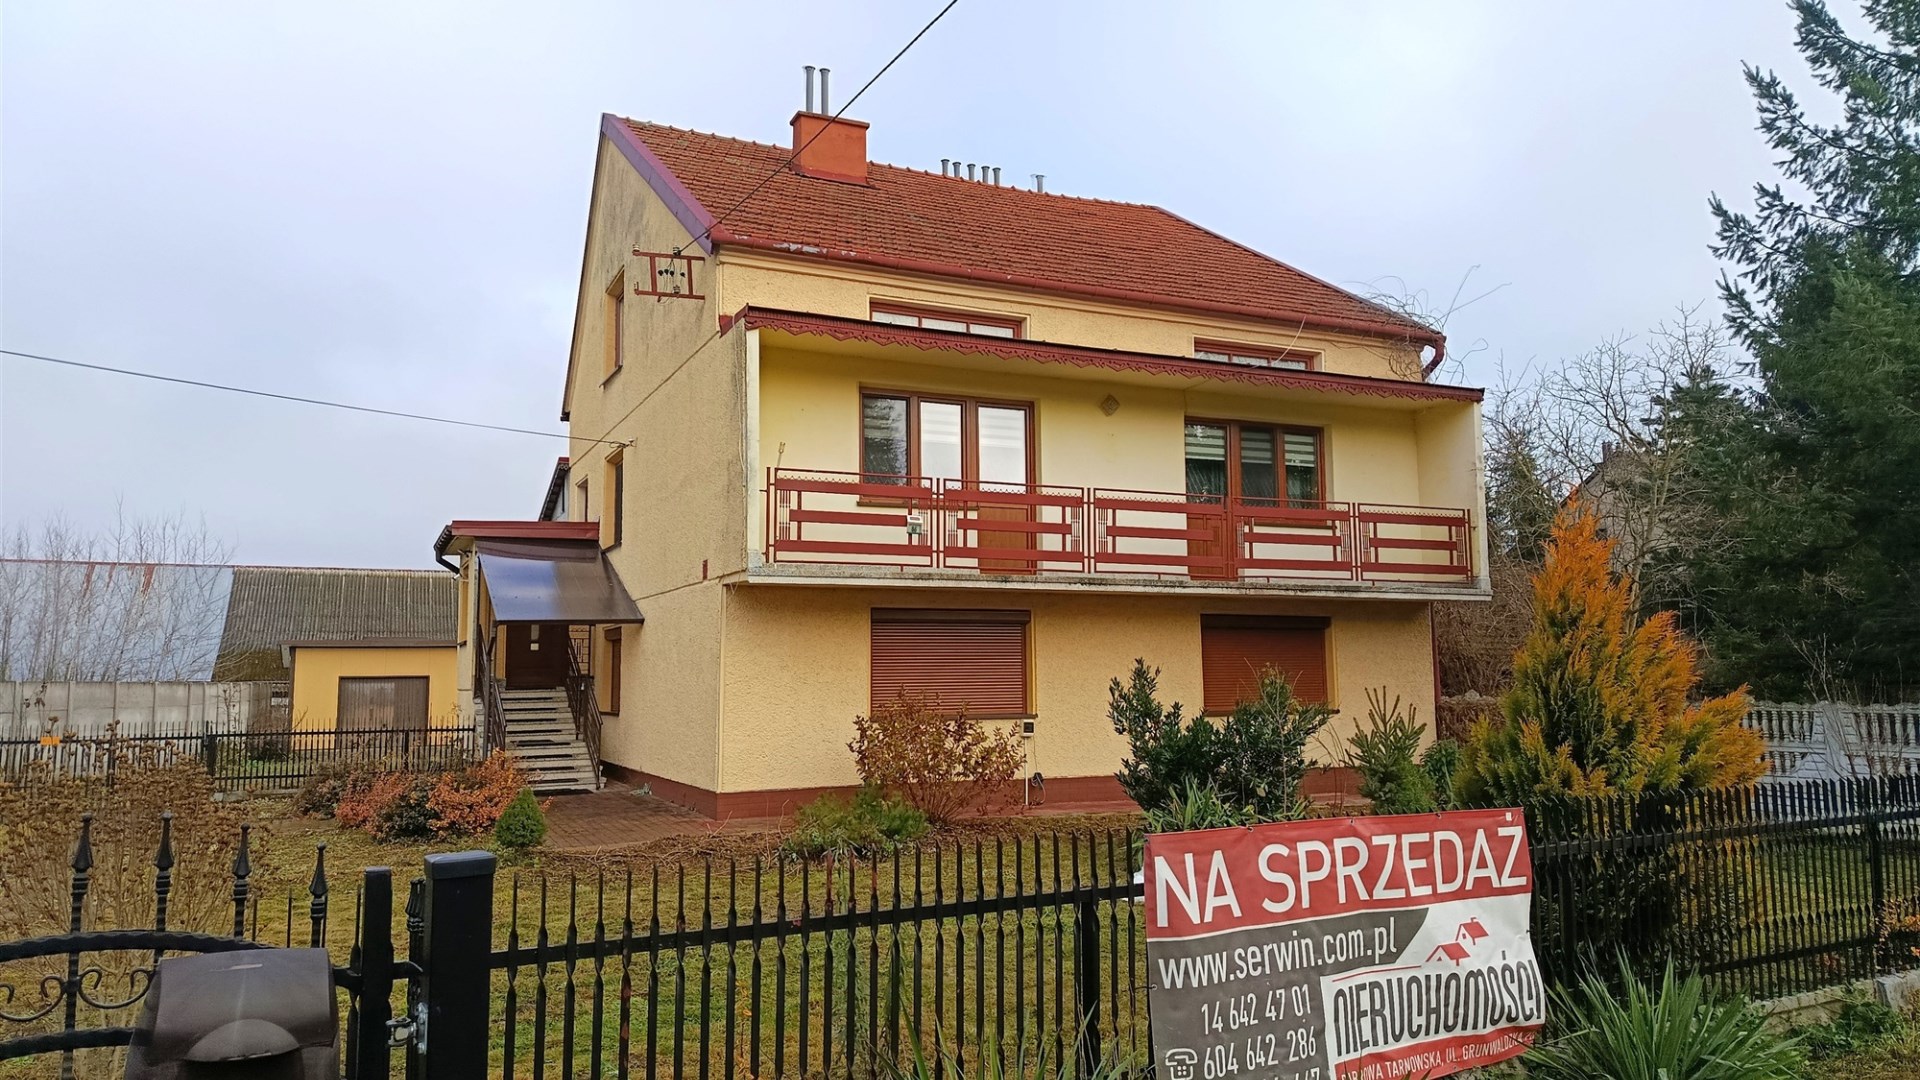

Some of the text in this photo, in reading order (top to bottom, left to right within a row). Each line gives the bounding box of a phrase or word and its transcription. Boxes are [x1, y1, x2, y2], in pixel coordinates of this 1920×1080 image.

[1154, 812, 1528, 928] NA SPRZEDAŻ
[1158, 916, 1398, 990] www.serwin.com.pl
[1201, 984, 1311, 1035] 14 642 47 01
[1333, 950, 1542, 1057] NIERUCHOMOŚCI
[1203, 1026, 1316, 1080] 604 642 286
[1384, 1050, 1444, 1078] TARNOWSKA,
[1445, 1046, 1460, 1063] UL.
